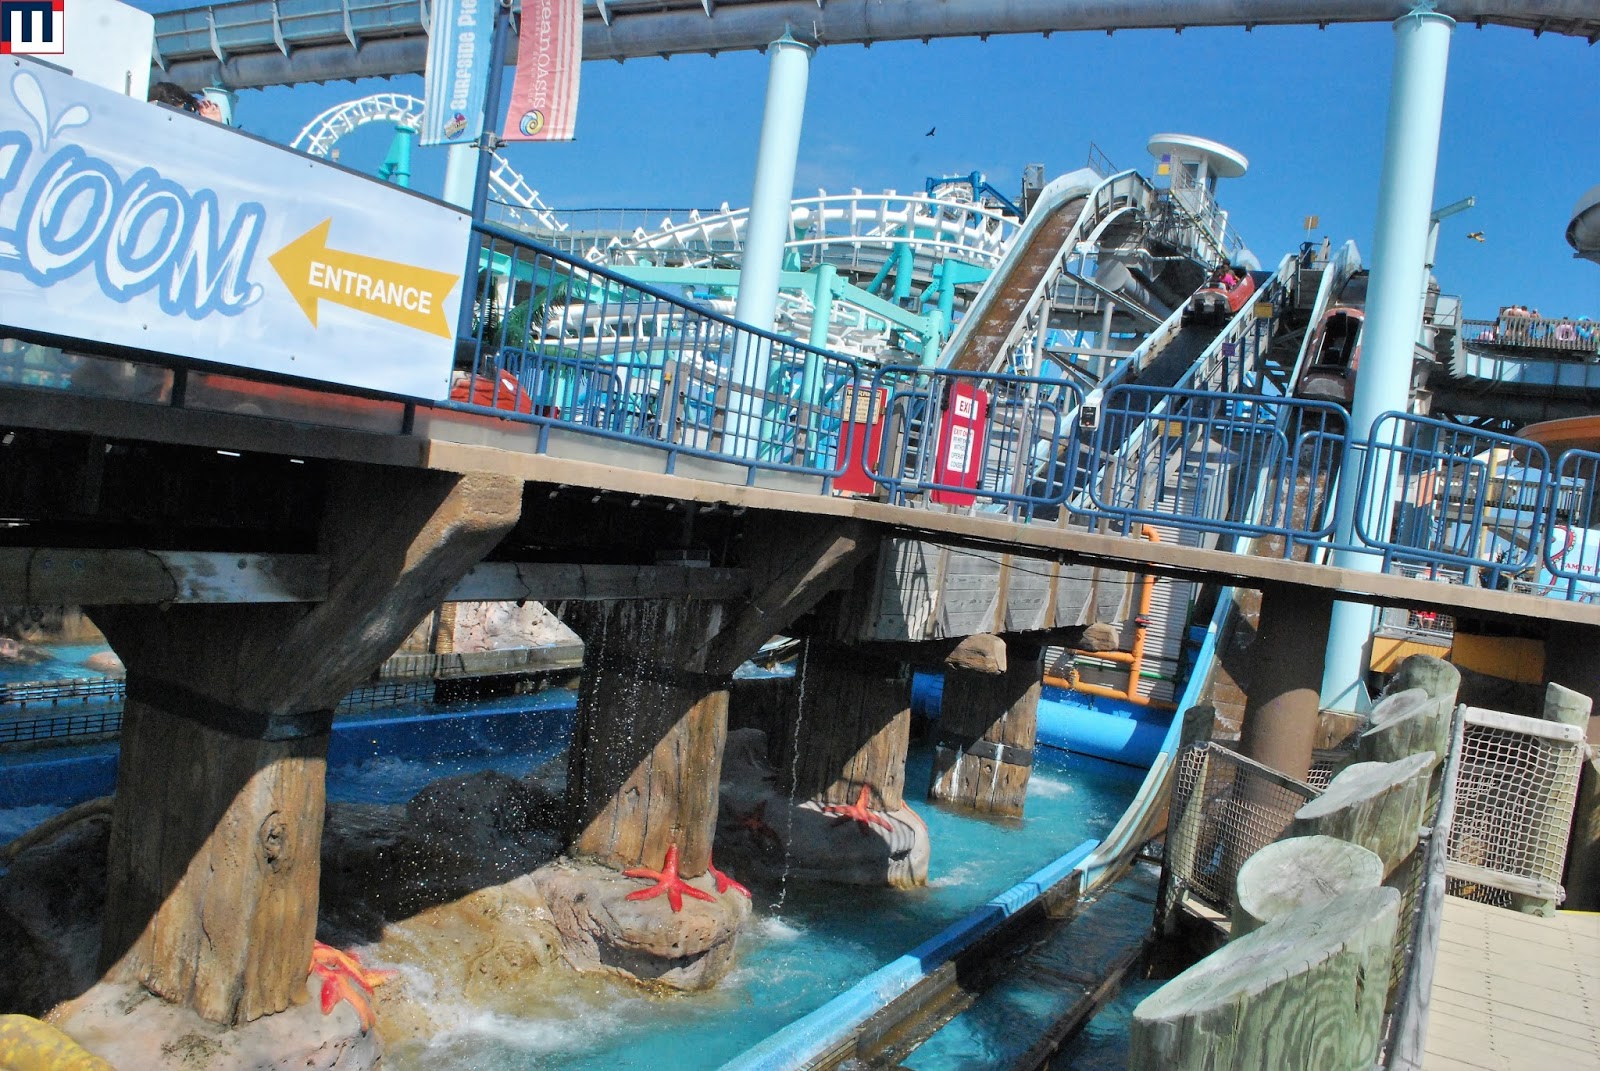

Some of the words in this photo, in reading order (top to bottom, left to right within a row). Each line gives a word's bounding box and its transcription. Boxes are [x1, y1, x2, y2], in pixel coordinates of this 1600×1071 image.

[308, 261, 433, 315] ENTRANCE
[959, 400, 973, 415] EXI
[1563, 562, 1593, 572] AMLY
